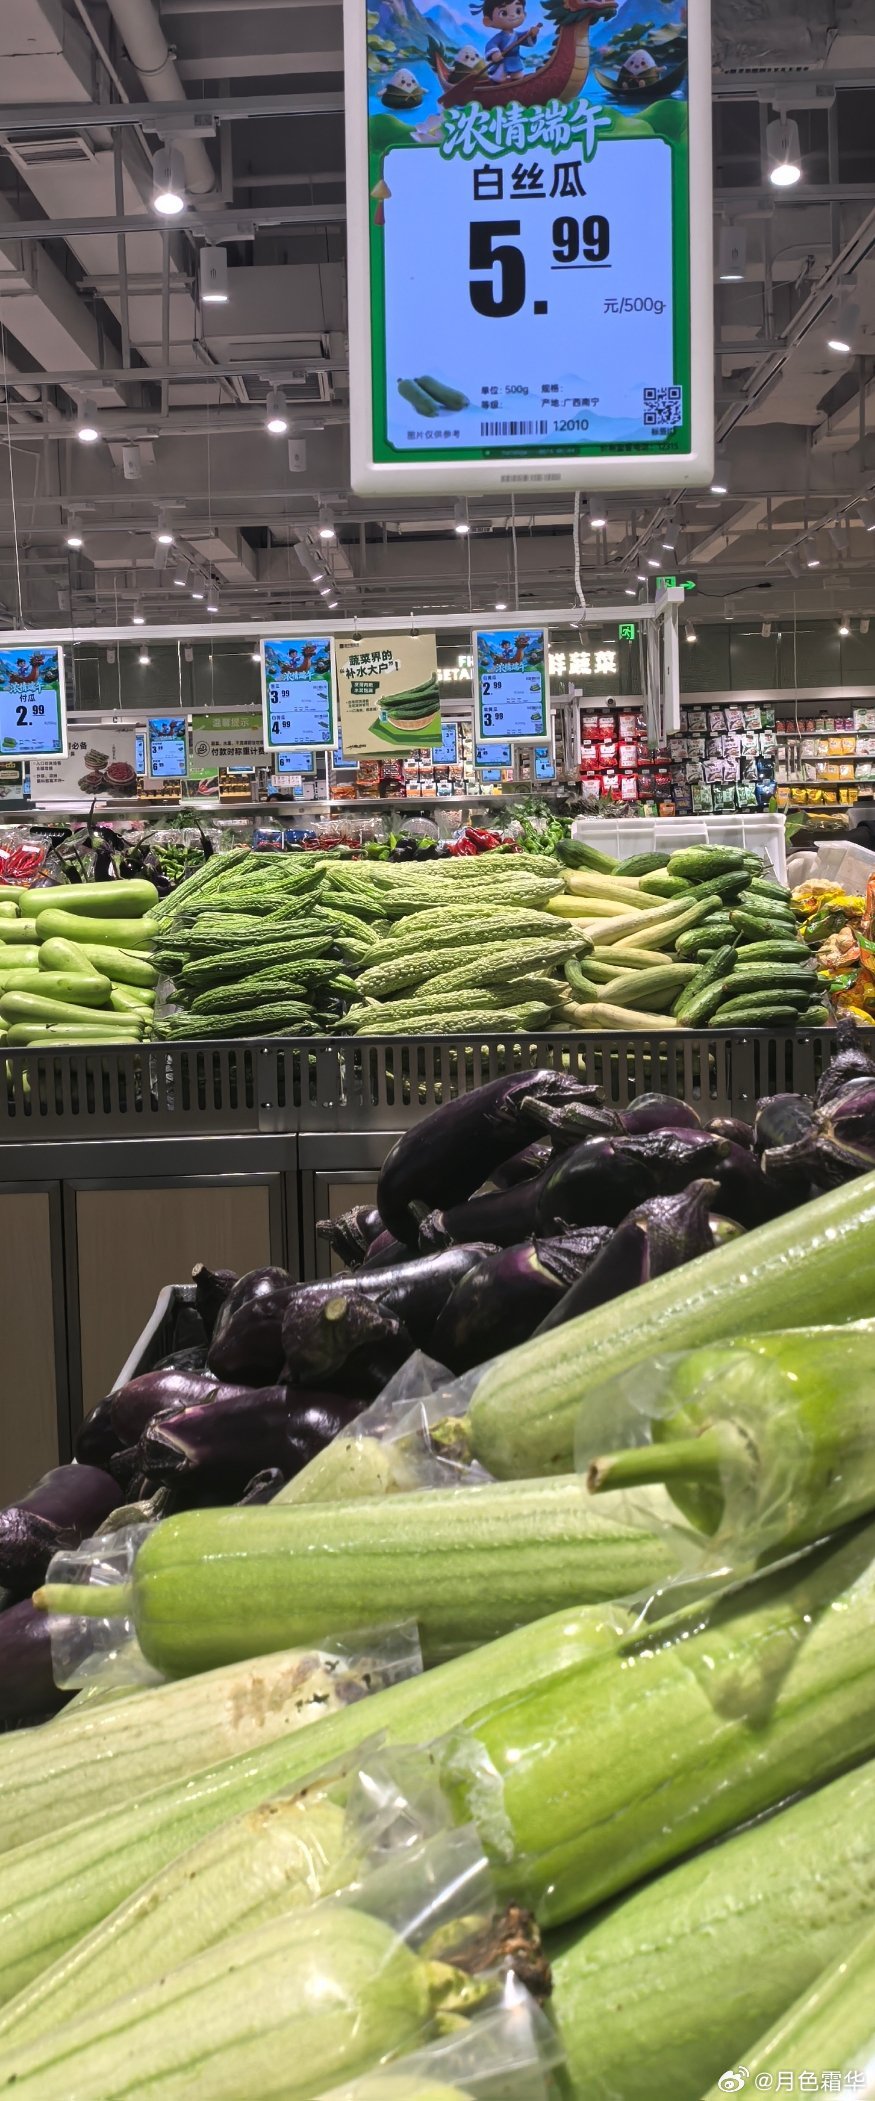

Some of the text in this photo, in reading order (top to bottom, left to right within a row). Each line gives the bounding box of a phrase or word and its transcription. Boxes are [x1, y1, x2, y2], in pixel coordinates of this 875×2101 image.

[443, 99, 612, 160] 浓情端午
[473, 160, 587, 200] 白丝瓜
[505, 385, 529, 395] 500g
[553, 419, 589, 431] 12010
[407, 430, 460, 440] 图片仅供参考
[349, 650, 392, 666] 蔬菜界的
